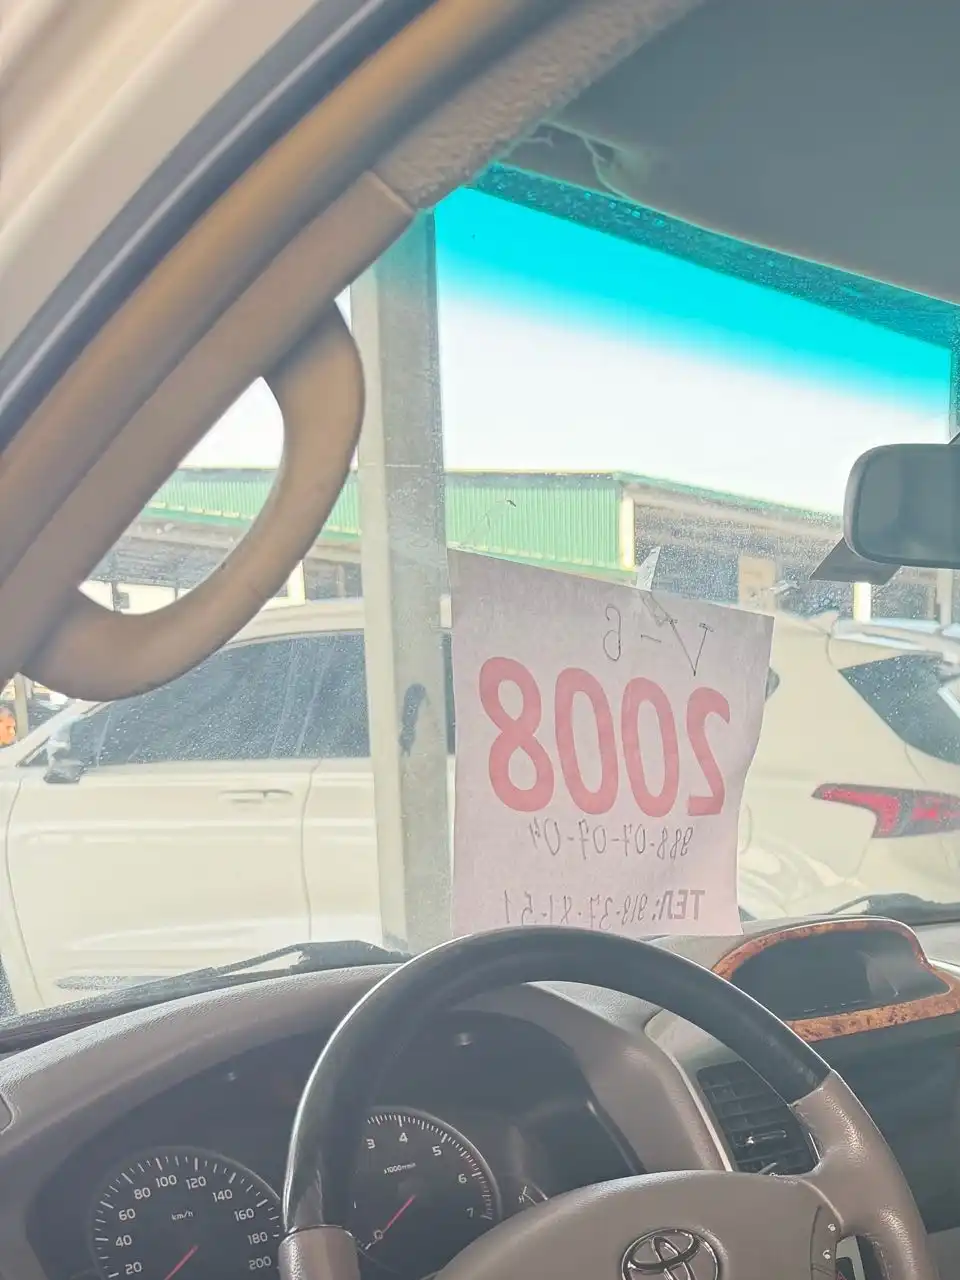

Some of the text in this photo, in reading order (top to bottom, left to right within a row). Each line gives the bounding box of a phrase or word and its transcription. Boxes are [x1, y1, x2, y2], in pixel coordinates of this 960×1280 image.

[366, 1139, 376, 1149] 3
[399, 1132, 408, 1143] 4
[432, 1145, 442, 1157] 5
[155, 1174, 177, 1188] 100
[186, 1176, 207, 1190] 120
[458, 1173, 467, 1184] 6
[134, 1187, 151, 1200] 80
[212, 1189, 233, 1203] 140
[118, 1208, 136, 1221] 60
[171, 1210, 194, 1222] km/h
[234, 1208, 255, 1222] 160
[466, 1207, 474, 1218] 7
[115, 1234, 132, 1247] 40
[247, 1231, 268, 1245] 180
[125, 1262, 143, 1275] 20
[249, 1256, 272, 1270] 200
